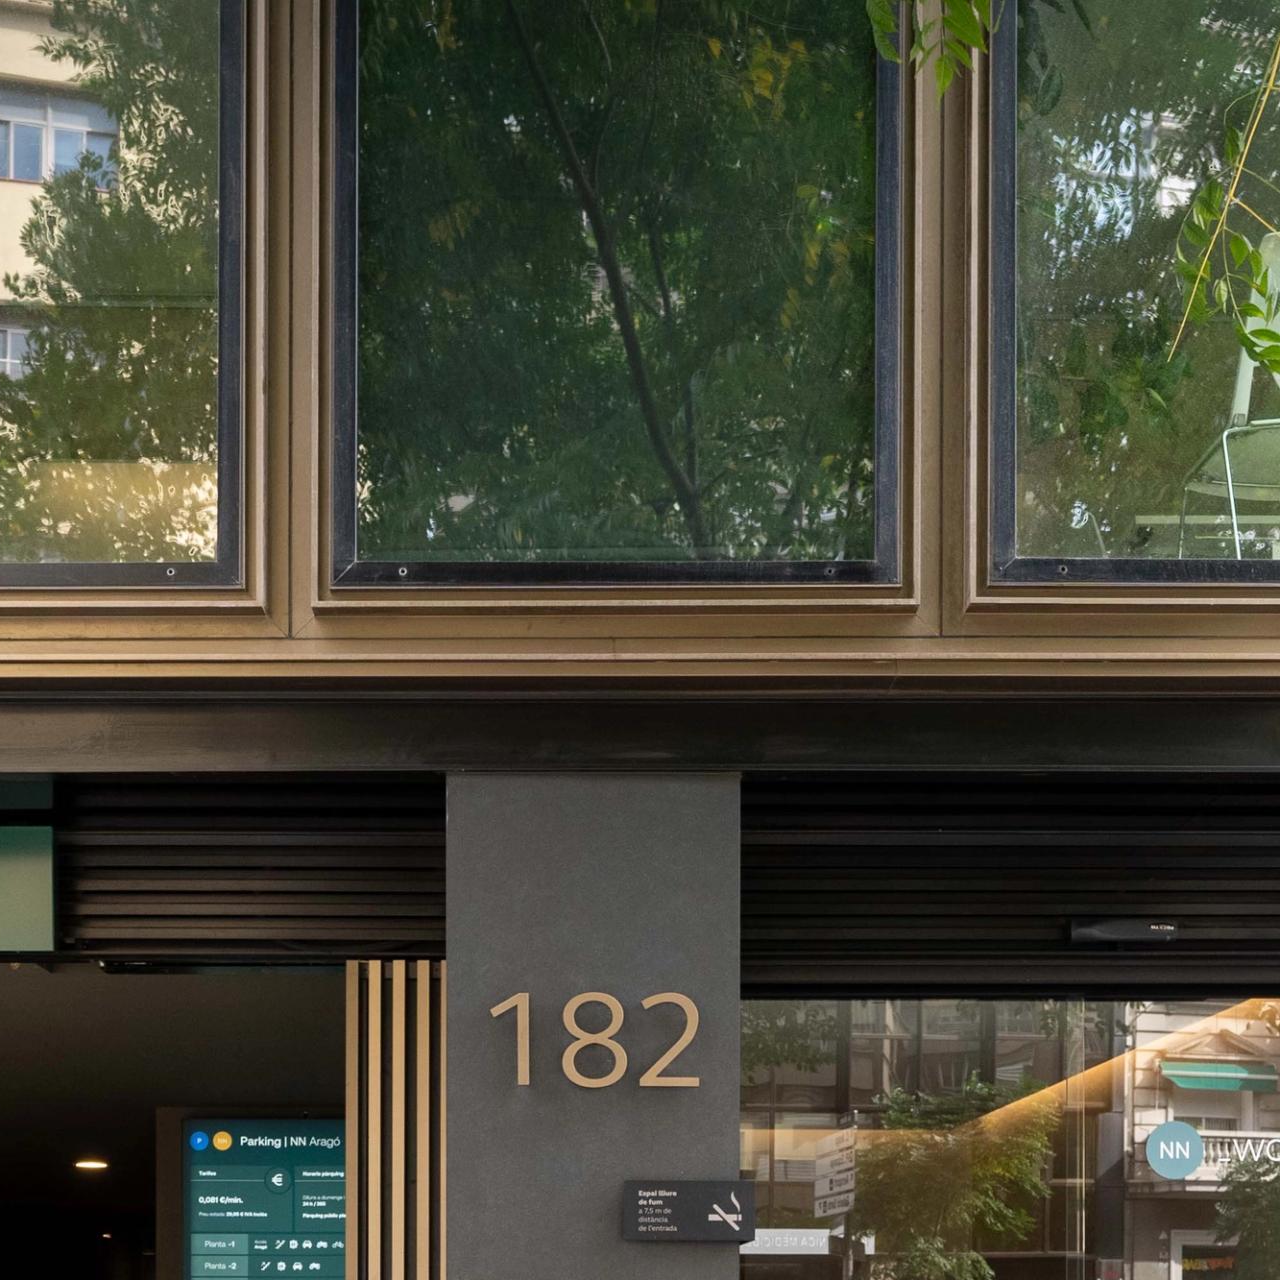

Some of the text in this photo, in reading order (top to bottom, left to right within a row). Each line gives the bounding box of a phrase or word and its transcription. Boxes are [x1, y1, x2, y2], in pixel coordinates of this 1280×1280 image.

[489, 991, 701, 1089] 182
[240, 1136, 282, 1149] Parking
[290, 1137, 306, 1146] NN
[309, 1136, 341, 1149] Aragó
[1159, 1141, 1191, 1160] NN
[204, 1240, 226, 1248] Planta
[204, 1262, 226, 1270] Planta
